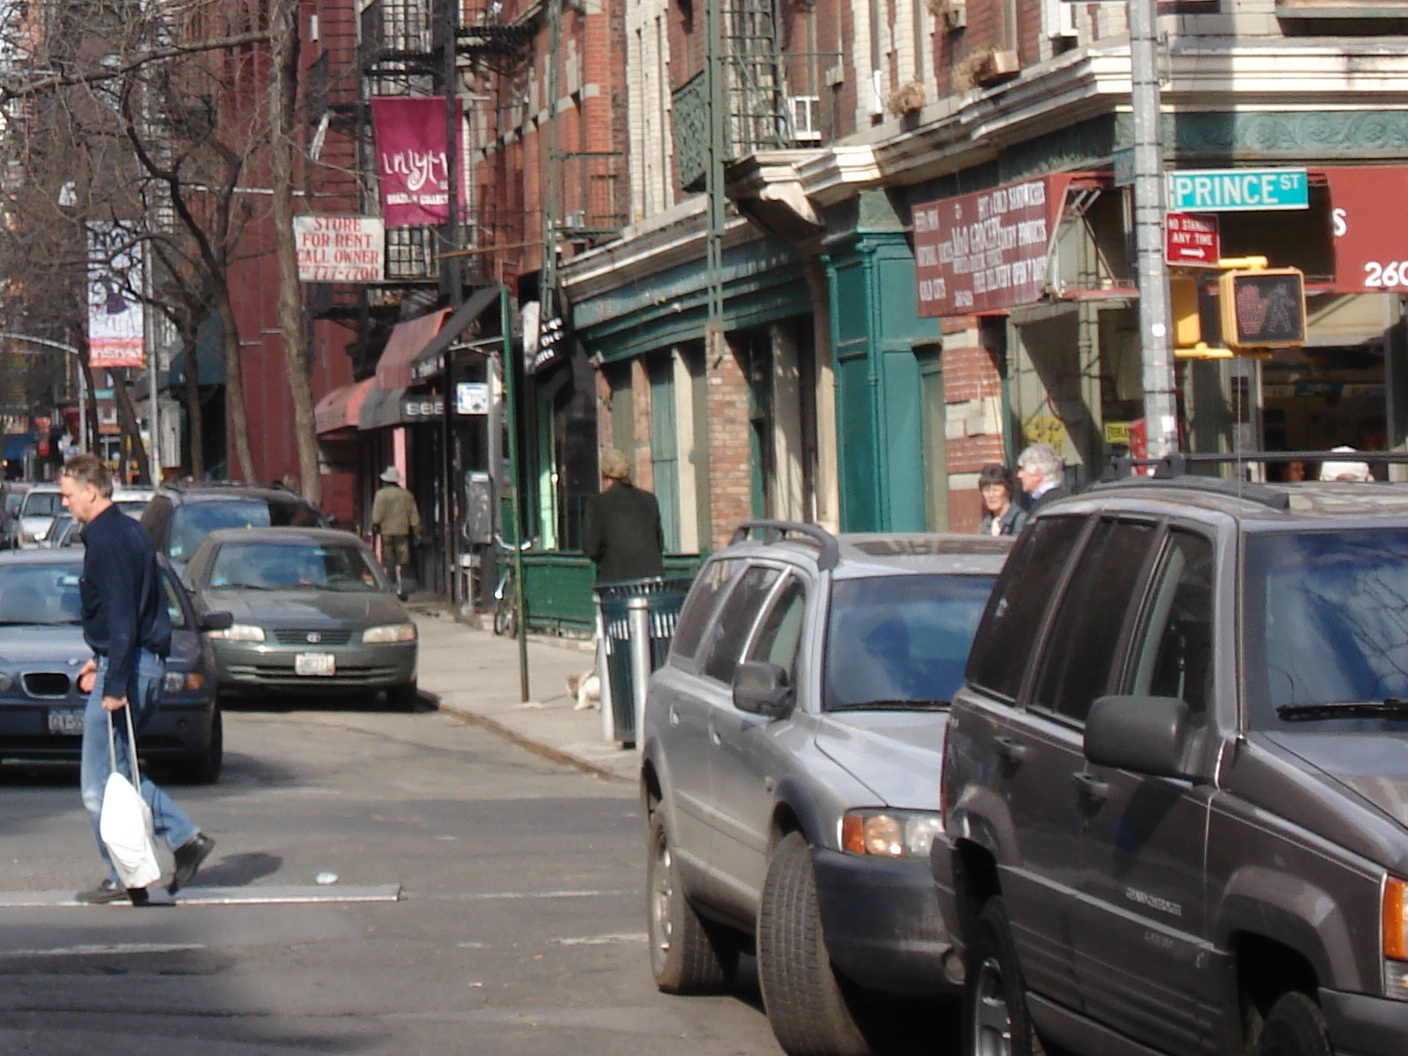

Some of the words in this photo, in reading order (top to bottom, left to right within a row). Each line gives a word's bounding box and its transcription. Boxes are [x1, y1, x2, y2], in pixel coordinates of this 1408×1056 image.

[1175, 174, 1280, 206] PRINCE
[1279, 173, 1301, 191] ST
[314, 216, 362, 233] STORE
[1168, 217, 1180, 229] NO
[302, 232, 331, 248] FOR
[334, 233, 374, 249] RENT
[1172, 231, 1191, 245] ANY
[1194, 232, 1213, 246] TIME
[296, 248, 330, 264] CALL
[334, 249, 379, 265] OWNER
[313, 265, 379, 281] 777-7700
